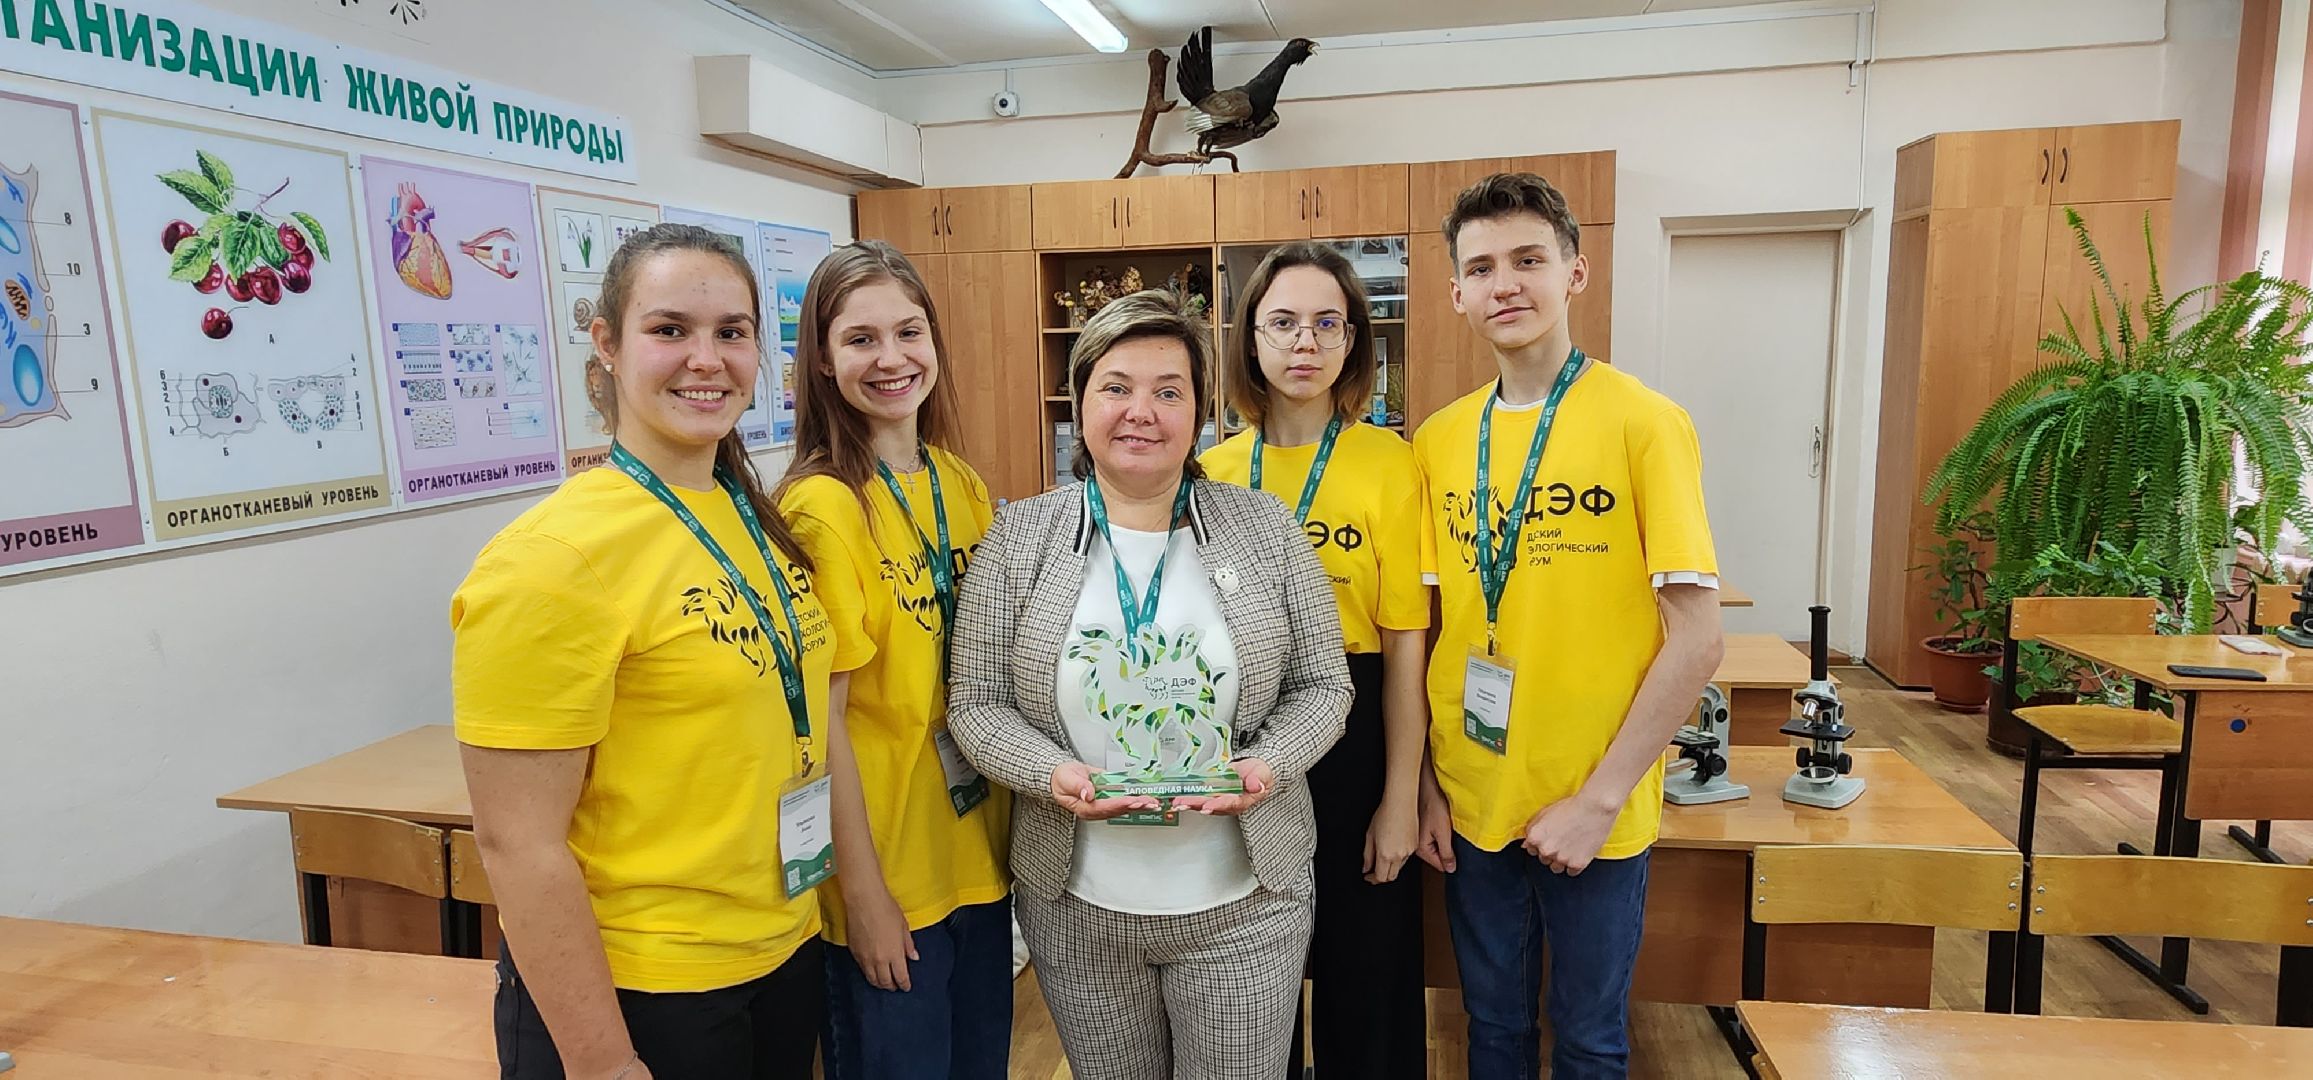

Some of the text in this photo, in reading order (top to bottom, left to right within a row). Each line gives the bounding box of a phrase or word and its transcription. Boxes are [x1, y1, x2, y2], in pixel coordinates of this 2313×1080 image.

[343, 63, 478, 135] ЖИВОЙ
[493, 101, 624, 164] ПРИРОДЫ
[64, 212, 72, 225] 8
[67, 262, 81, 276] 10
[83, 323, 91, 335] 3
[269, 334, 275, 344] А
[91, 378, 98, 391] 9
[161, 381, 168, 391] 3
[163, 392, 170, 403] 2
[408, 460, 556, 493] ОРГАНОТКАНЕВЫЙ УРОВЕНЬ
[167, 485, 379, 528] ОРГАНОТКАНЕВЫЙ УРОВЕНЬ
[1524, 483, 1615, 524] ДЭФ
[0, 523, 98, 552] УРОВЕНЬ
[1305, 520, 1363, 552] ЭФ
[1328, 574, 1351, 586] СКИЙ
[1171, 677, 1197, 688] ДЭФ
[1184, 785, 1213, 793] НАУКА
